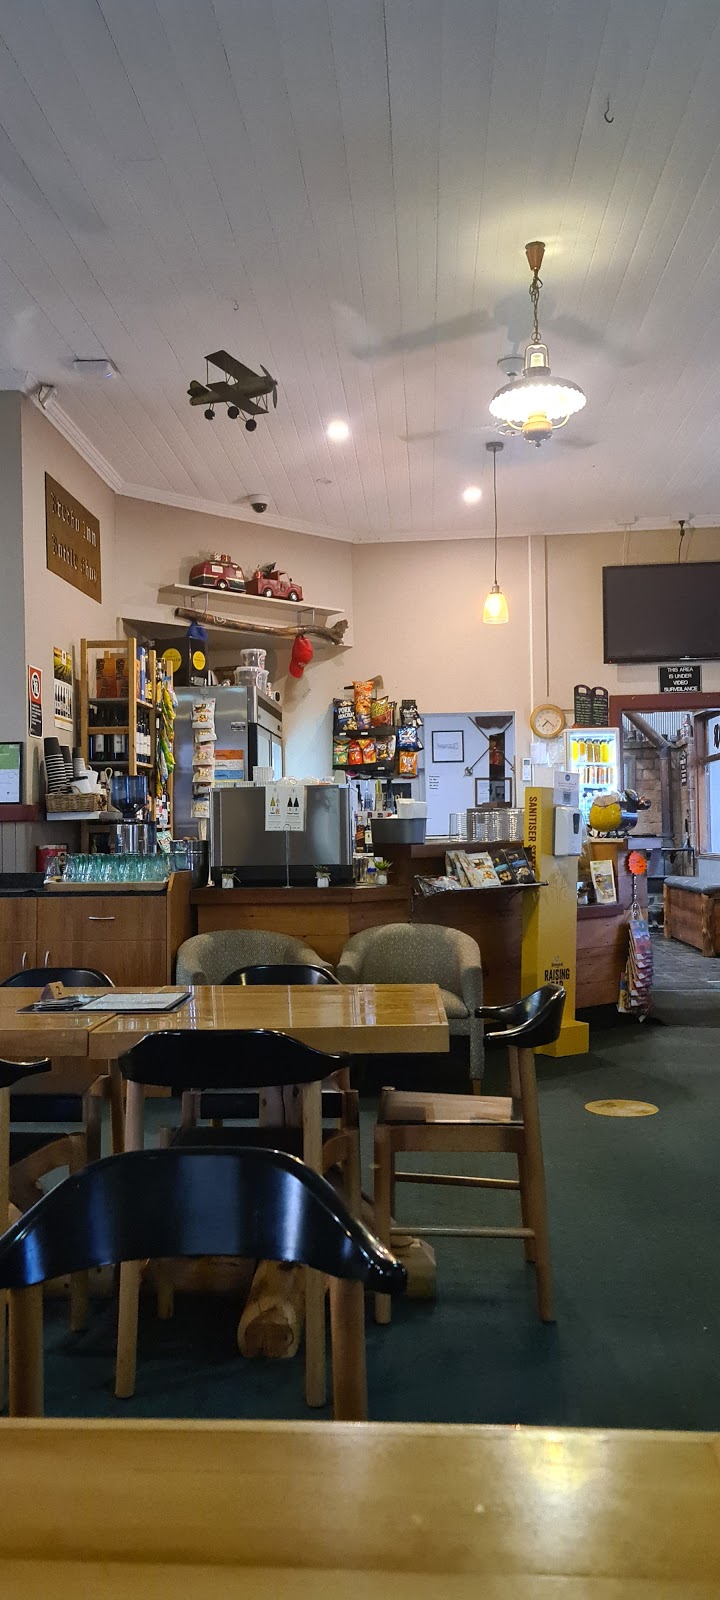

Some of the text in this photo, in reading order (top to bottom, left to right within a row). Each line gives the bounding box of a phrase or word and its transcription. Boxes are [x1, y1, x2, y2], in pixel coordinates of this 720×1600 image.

[82, 520, 97, 547] Inn
[51, 534, 78, 570] Bottle
[338, 706, 352, 714] PORK
[528, 796, 538, 842] SANITISER
[544, 968, 571, 981] RAISING
